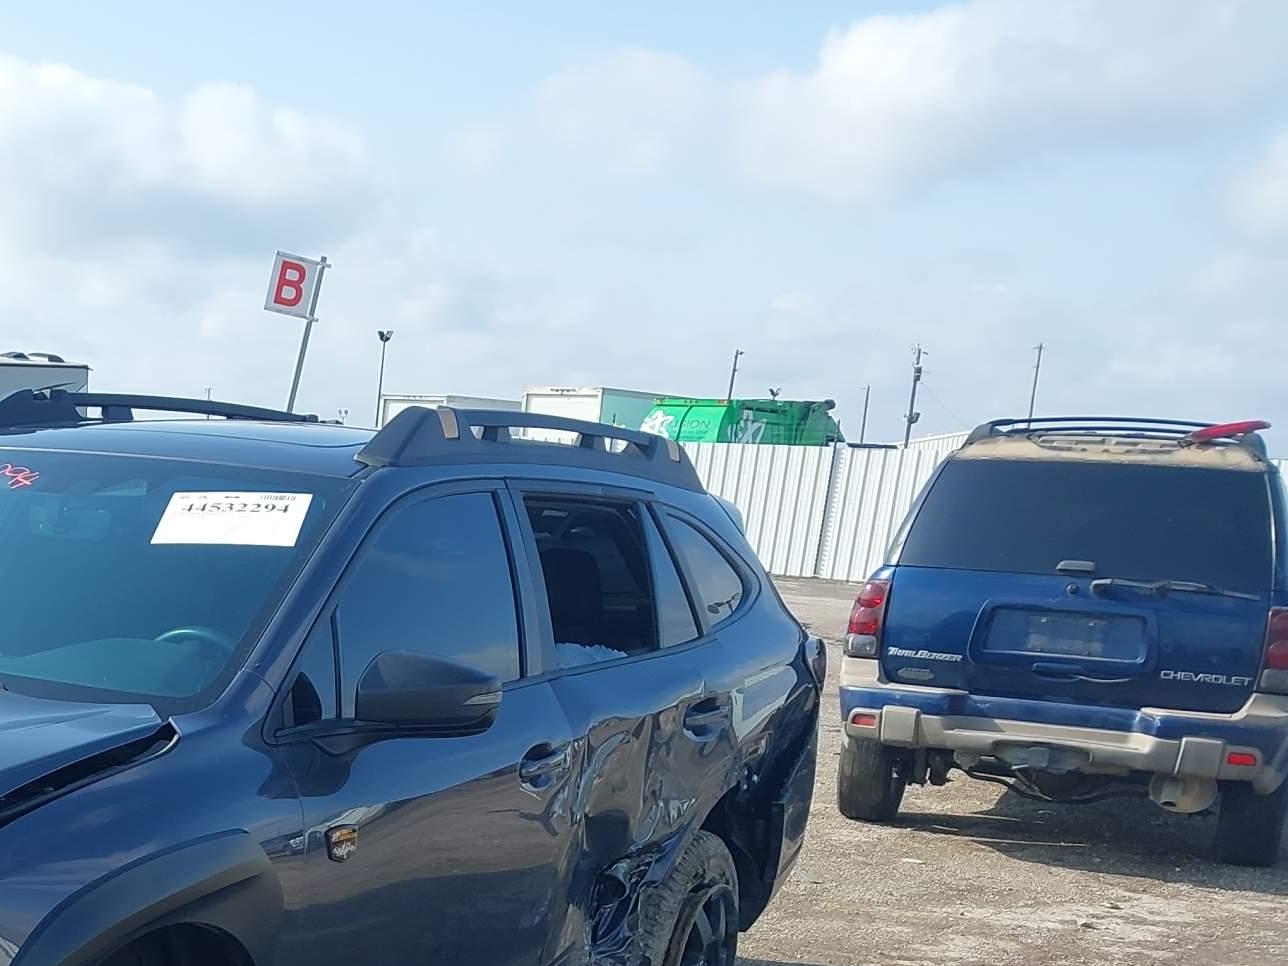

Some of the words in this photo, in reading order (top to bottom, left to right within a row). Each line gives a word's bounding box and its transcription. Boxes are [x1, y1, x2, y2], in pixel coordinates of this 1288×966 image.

[274, 260, 306, 307] B
[182, 502, 290, 513] 44532294
[1160, 669, 1254, 686] CHEVROLET
